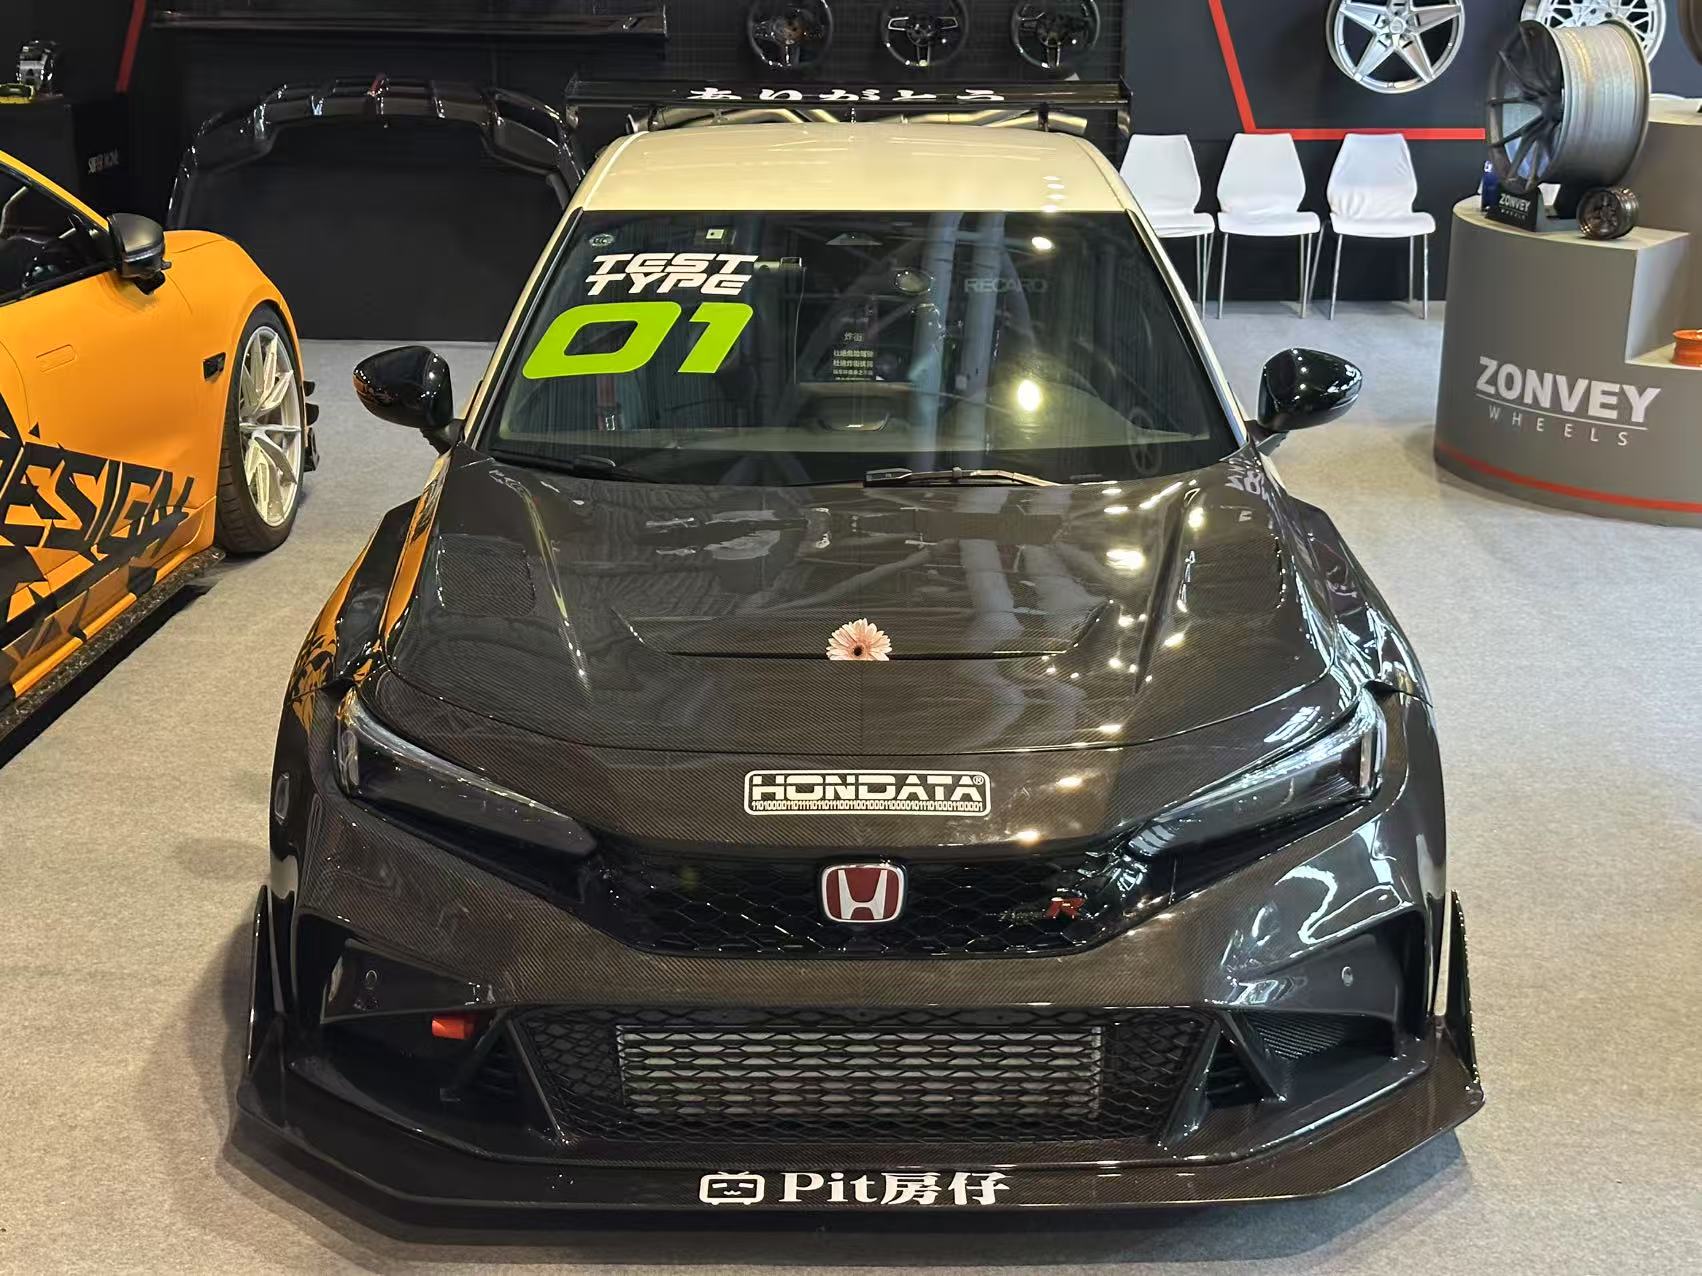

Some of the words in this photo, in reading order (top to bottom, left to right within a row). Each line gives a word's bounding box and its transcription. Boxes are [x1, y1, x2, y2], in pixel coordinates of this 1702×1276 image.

[1498, 193, 1532, 212] ZONVEY
[592, 252, 759, 275] TEST
[585, 271, 752, 296] TYPE
[522, 301, 754, 380] 01
[1476, 356, 1661, 423] ZONVEY
[1489, 404, 1629, 446] WHEELS
